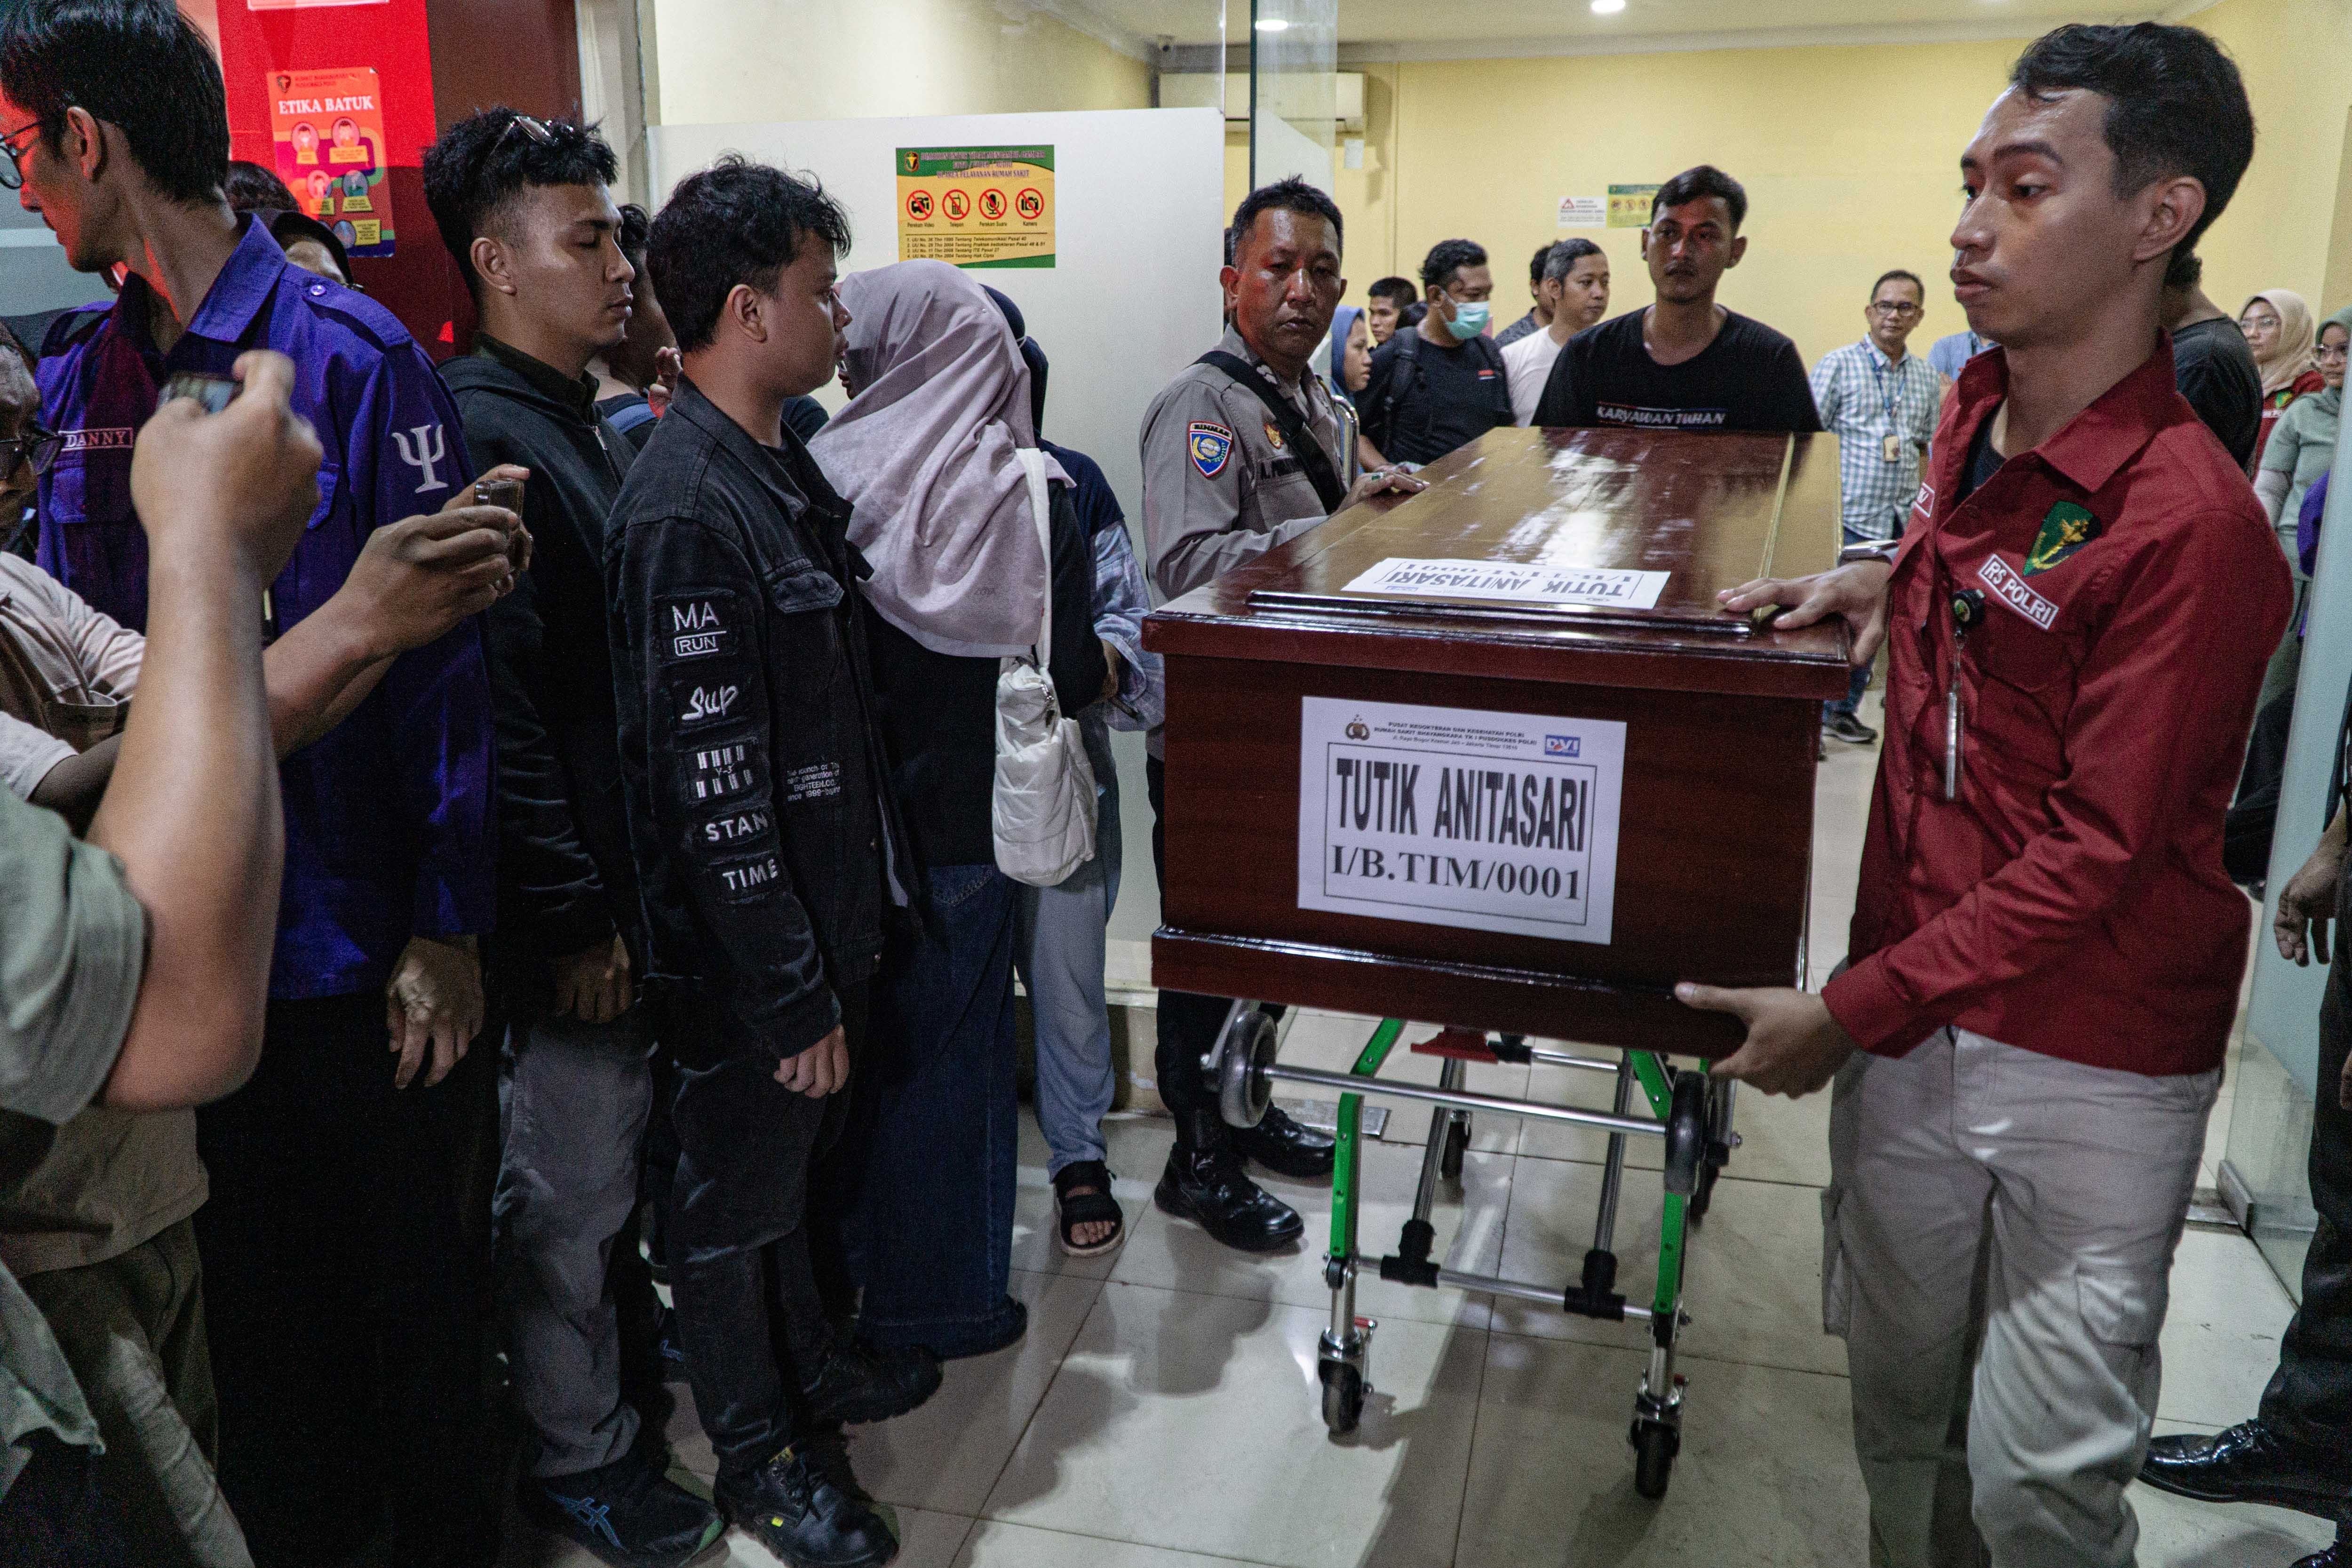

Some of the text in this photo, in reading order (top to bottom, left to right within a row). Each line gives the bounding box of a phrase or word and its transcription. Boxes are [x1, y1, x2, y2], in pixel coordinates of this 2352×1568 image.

[278, 96, 375, 114] ETIKA BATUK
[65, 431, 126, 447] DANNY
[1385, 572, 1531, 590] ANITASARI
[1542, 580, 1622, 596] TUTIK
[1985, 561, 2051, 622] RS POLRI
[672, 602, 720, 631] MA
[679, 636, 716, 653] RUN
[682, 685, 739, 720] Sup
[1546, 738, 1579, 753] DVI
[715, 763, 735, 776] Y-3
[1336, 758, 1588, 852] TUTIK ANITASARI
[706, 811, 768, 842] STAN
[722, 859, 778, 890] TIME
[1331, 845, 1581, 899] I/B.TIM/0001
